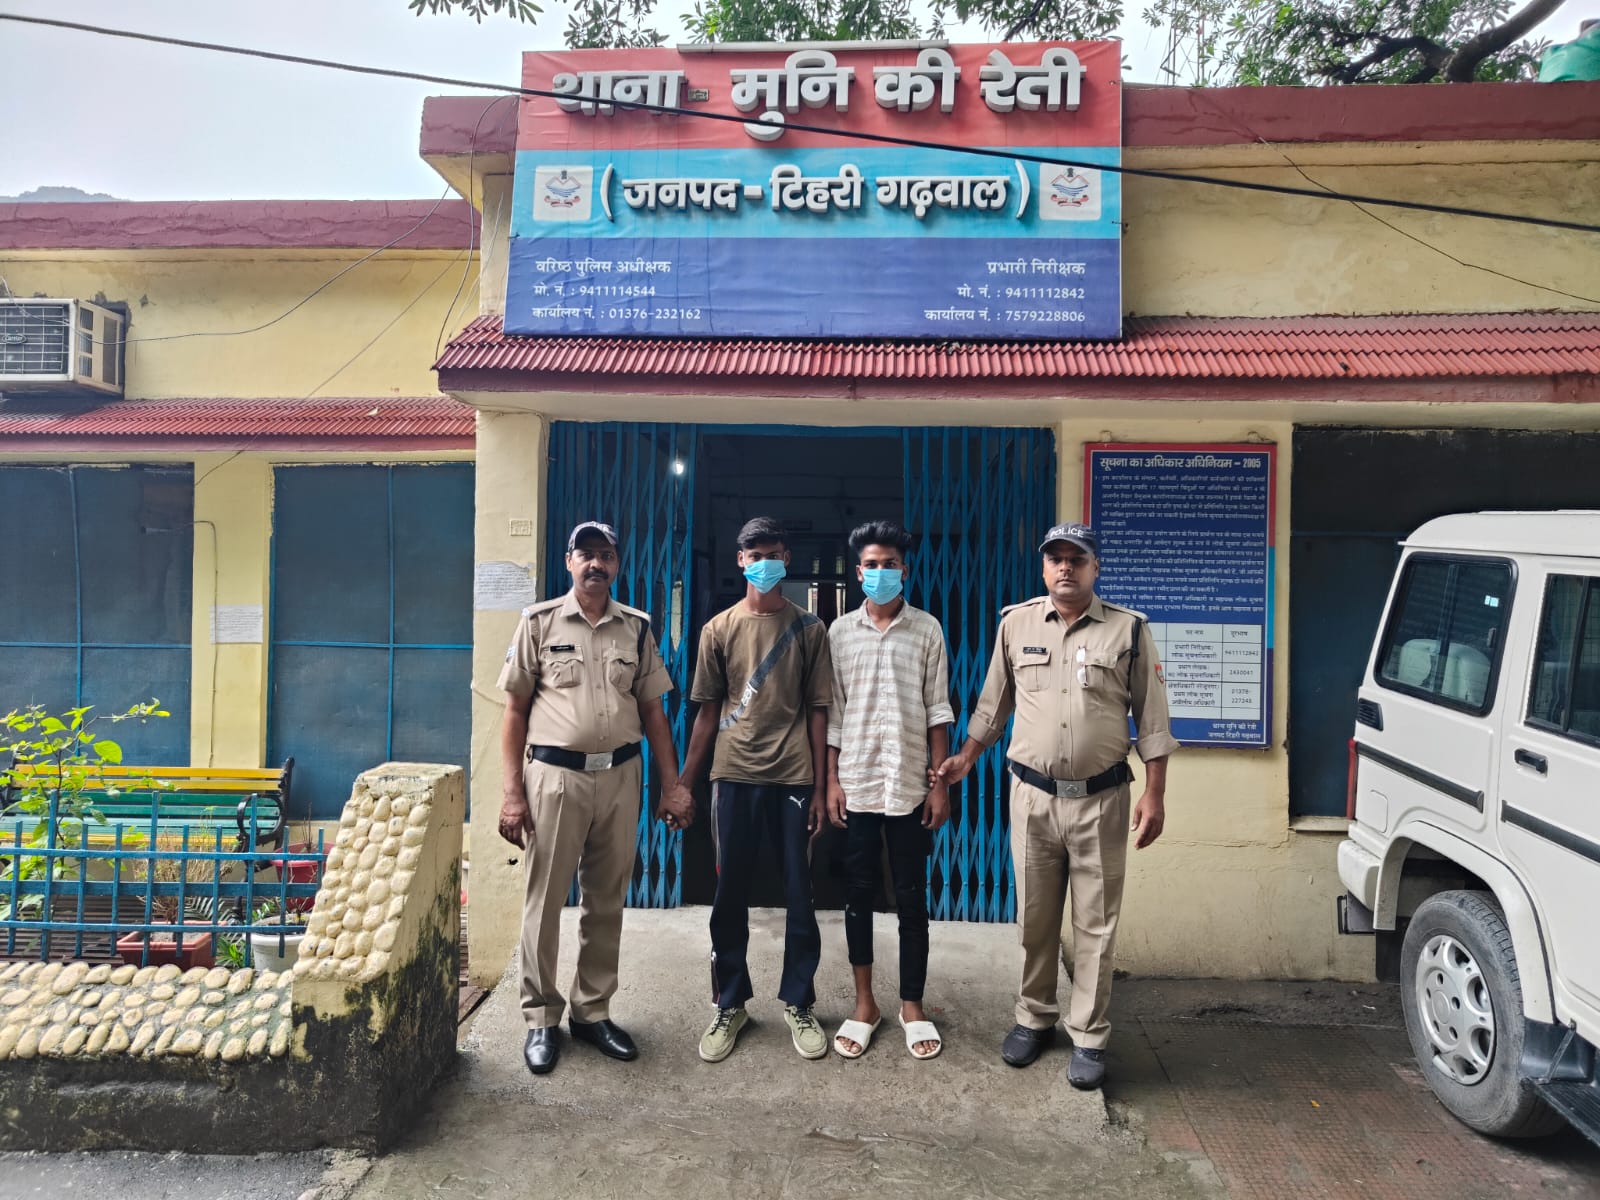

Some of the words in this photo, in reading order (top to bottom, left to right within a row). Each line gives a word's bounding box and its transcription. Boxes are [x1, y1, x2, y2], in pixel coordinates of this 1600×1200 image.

[730, 50, 855, 142] मुनि
[873, 48, 961, 113] की
[979, 47, 1088, 113] रेती
[536, 257, 572, 273] वरिष्ठ
[575, 257, 612, 277] पुलिस
[617, 257, 672, 274] अधीक्षक
[986, 259, 1027, 275] प्रभारी
[1031, 258, 1086, 276] निरीक्षक
[533, 282, 549, 297] मो.
[554, 282, 565, 297] नं.
[579, 286, 656, 297] 9411114544
[957, 284, 974, 298] मो.
[978, 284, 991, 298] नं.
[1005, 287, 1085, 299] 9411112842
[532, 304, 580, 319] कार्यालय
[583, 304, 595, 319] नं.
[609, 308, 701, 320] 01376-232162
[924, 306, 974, 321] कार्यालय
[978, 307, 991, 321] नं.
[1005, 310, 1085, 322] 7579228806
[1100, 457, 1127, 471] सूचना
[1129, 457, 1143, 467] का
[1144, 455, 1184, 468] अधिकार
[1184, 455, 1232, 468] अधिनियम
[1242, 458, 1262, 468] 2005
[1050, 527, 1084, 538] POLICE
